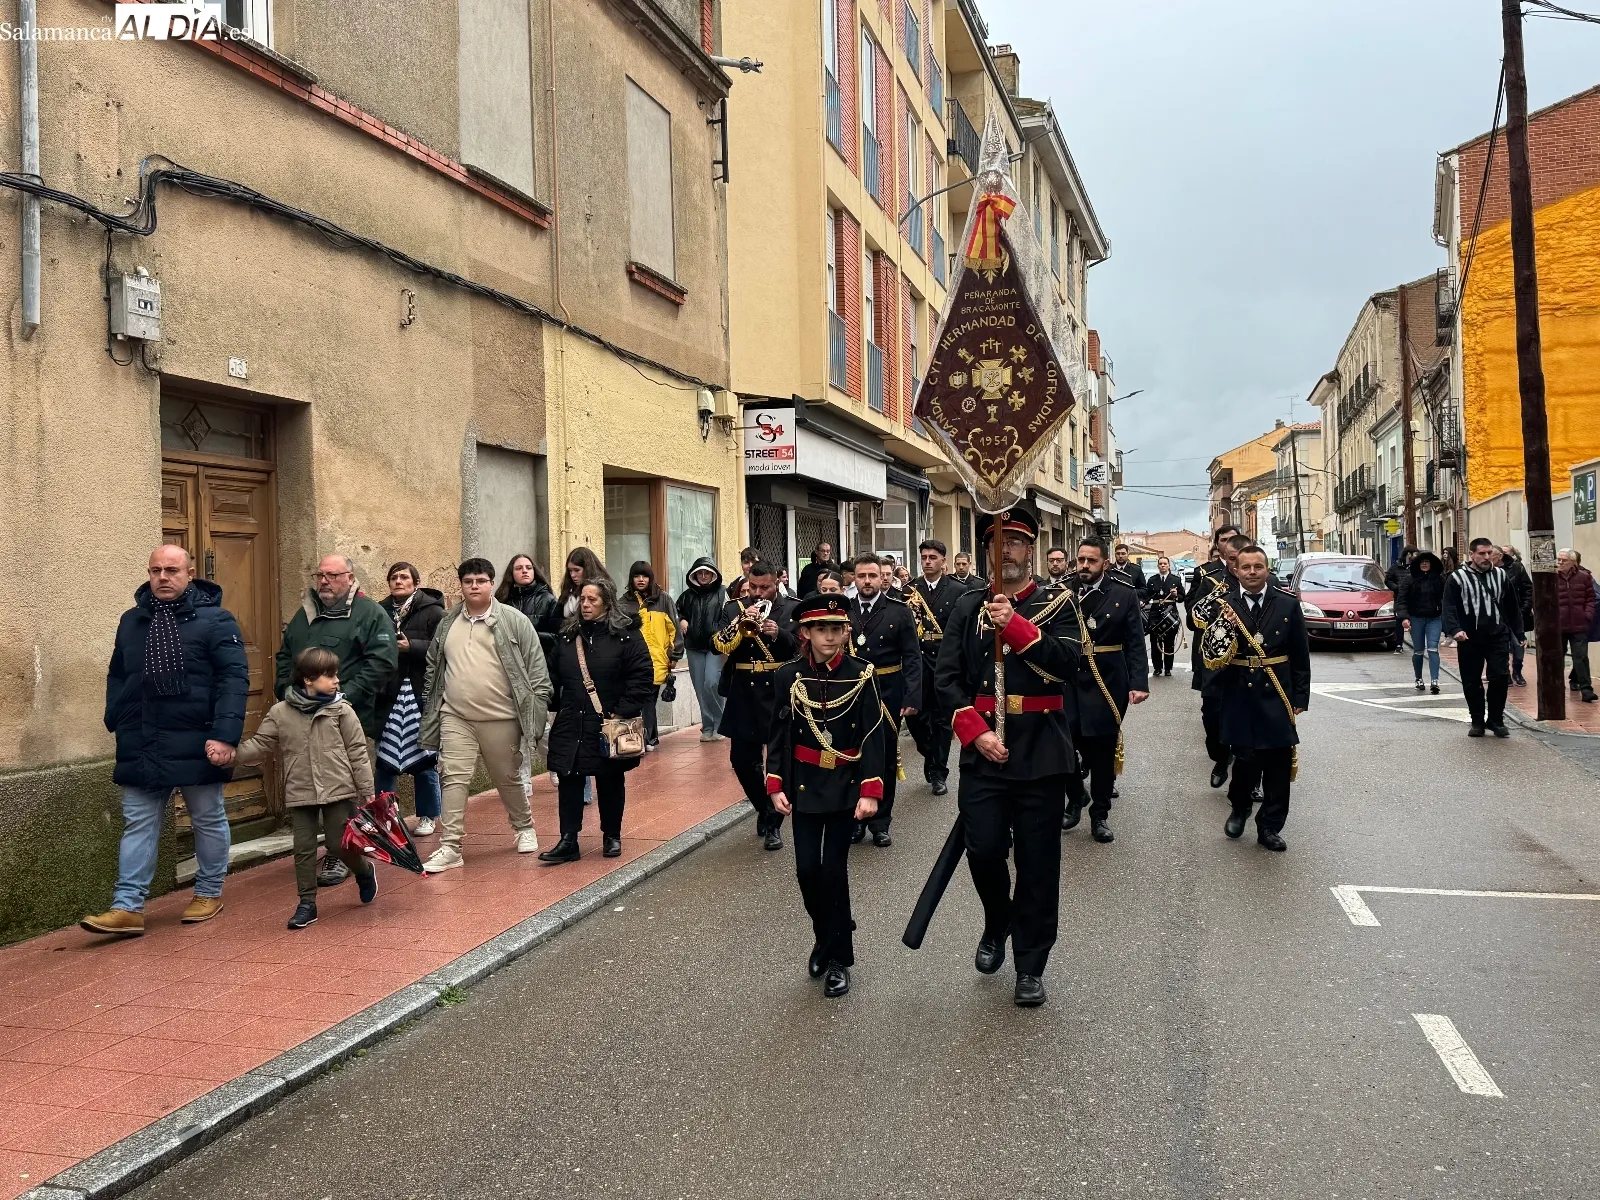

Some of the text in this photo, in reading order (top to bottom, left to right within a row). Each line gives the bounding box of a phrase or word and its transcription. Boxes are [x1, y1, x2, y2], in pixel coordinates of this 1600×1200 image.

[964, 288, 1017, 300] PEÑARANDA
[985, 297, 995, 305] DE
[961, 301, 1021, 315] BRACAMONTE
[940, 315, 1016, 351] HERMANDAD
[1025, 323, 1045, 342] DE
[928, 358, 942, 386] CYT
[930, 396, 958, 438] BANDA
[979, 435, 1008, 446] 1954
[745, 449, 793, 459] STREET 54
[748, 462, 770, 472] moda
